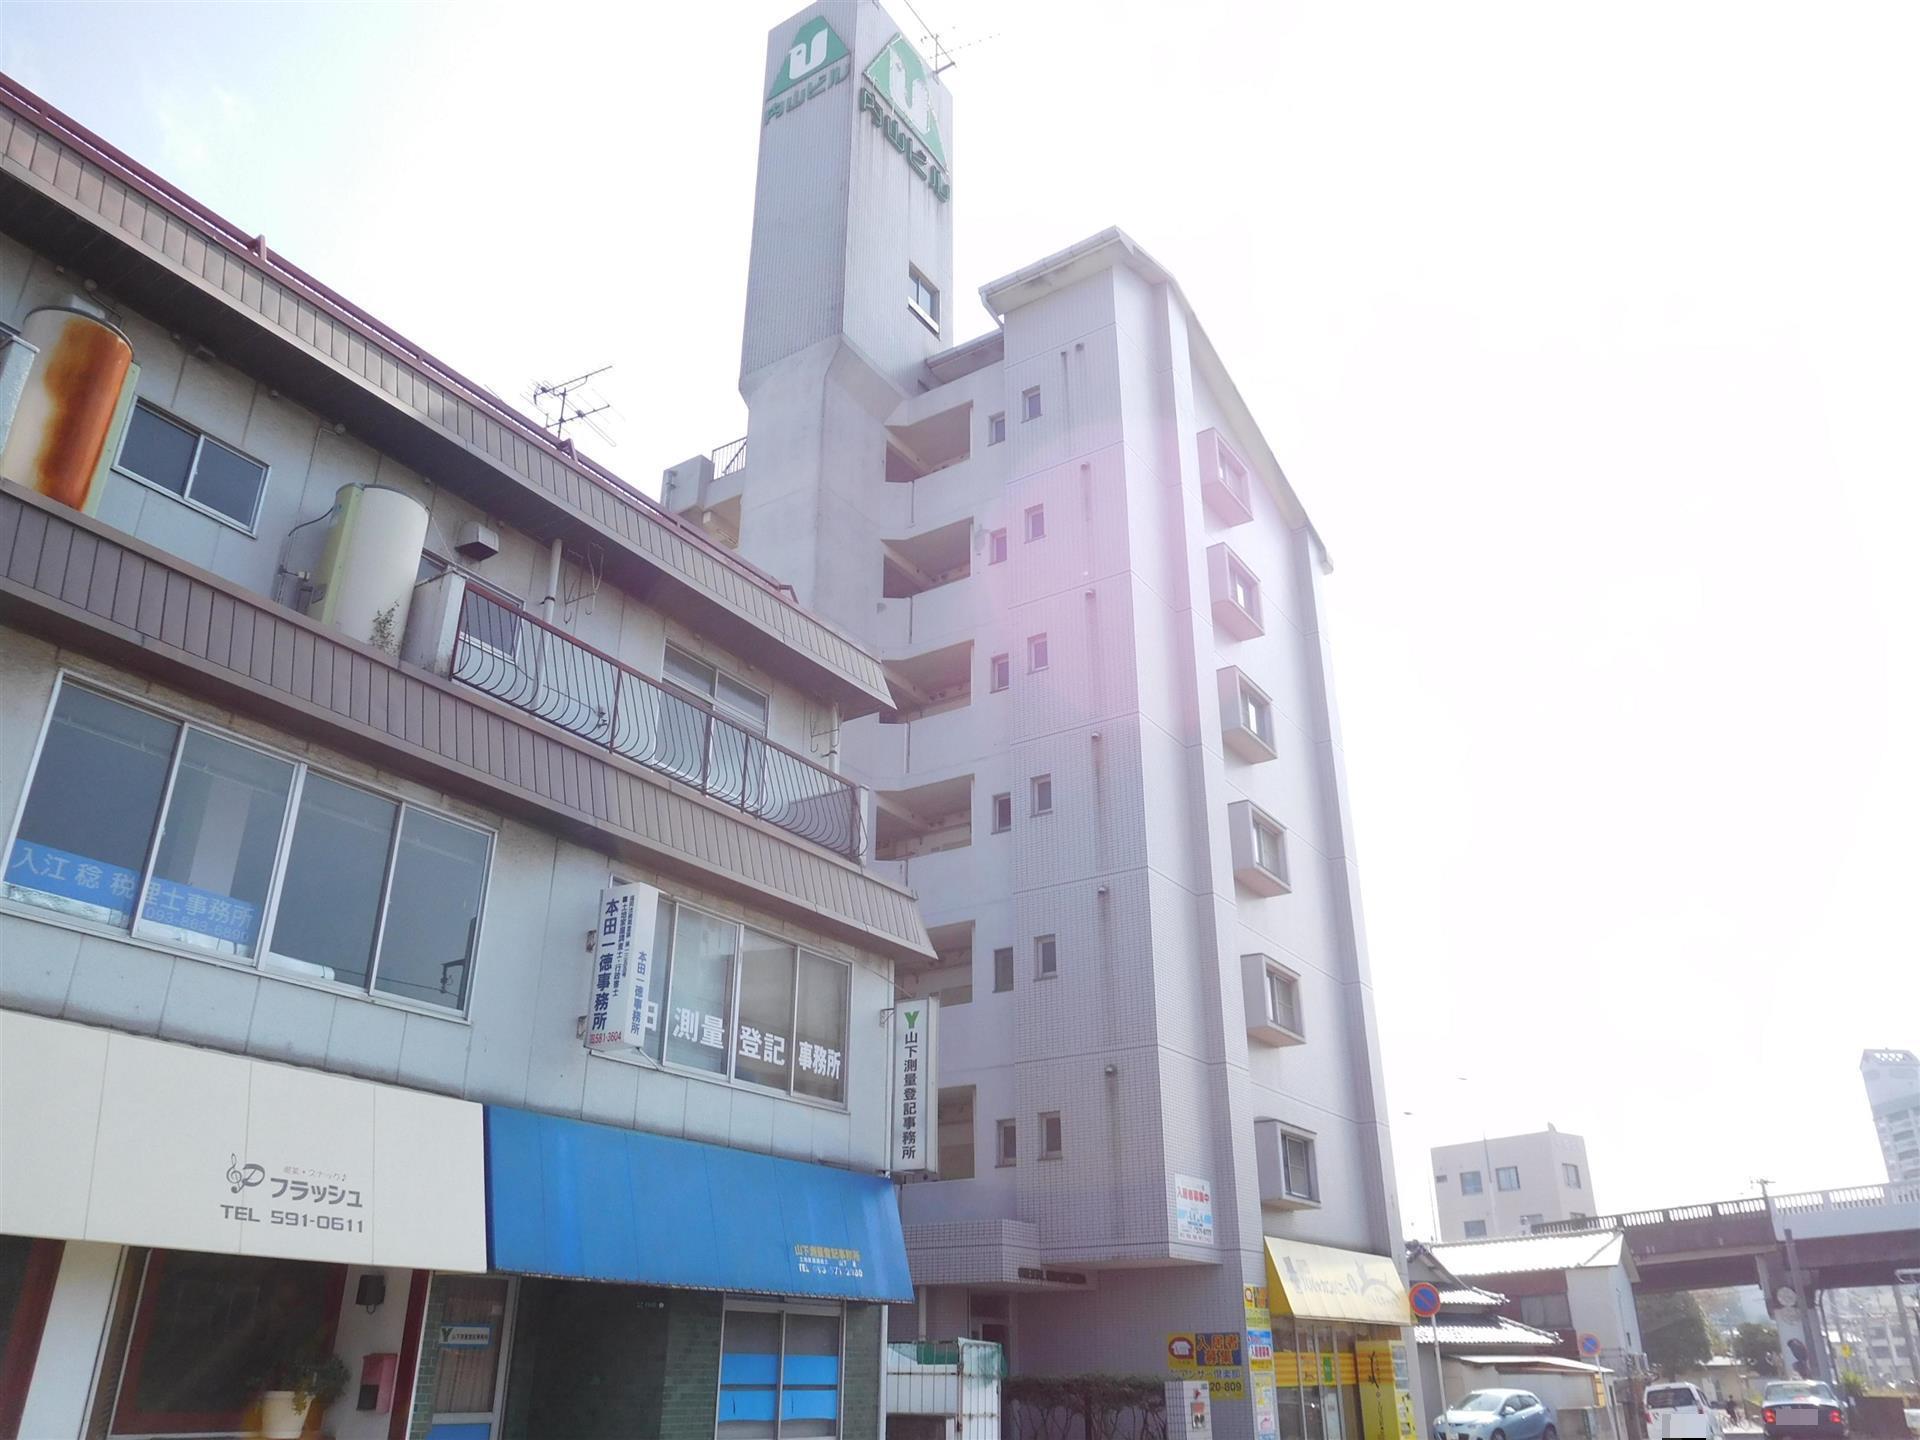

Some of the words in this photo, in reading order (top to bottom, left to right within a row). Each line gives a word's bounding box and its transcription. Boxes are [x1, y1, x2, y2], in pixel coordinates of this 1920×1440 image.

[591, 898, 619, 1031] 本田一徳事務所
[630, 951, 648, 1036] 本田一徳事務所
[672, 1007, 725, 1050] 測量
[738, 1025, 785, 1067] 登記
[798, 1041, 842, 1080] 事務所
[901, 1030, 918, 1160] 山下測量登記事務所
[220, 1204, 261, 1223] TEL
[270, 1210, 364, 1233] 591-0611
[270, 1177, 364, 1208] フラッシュ
